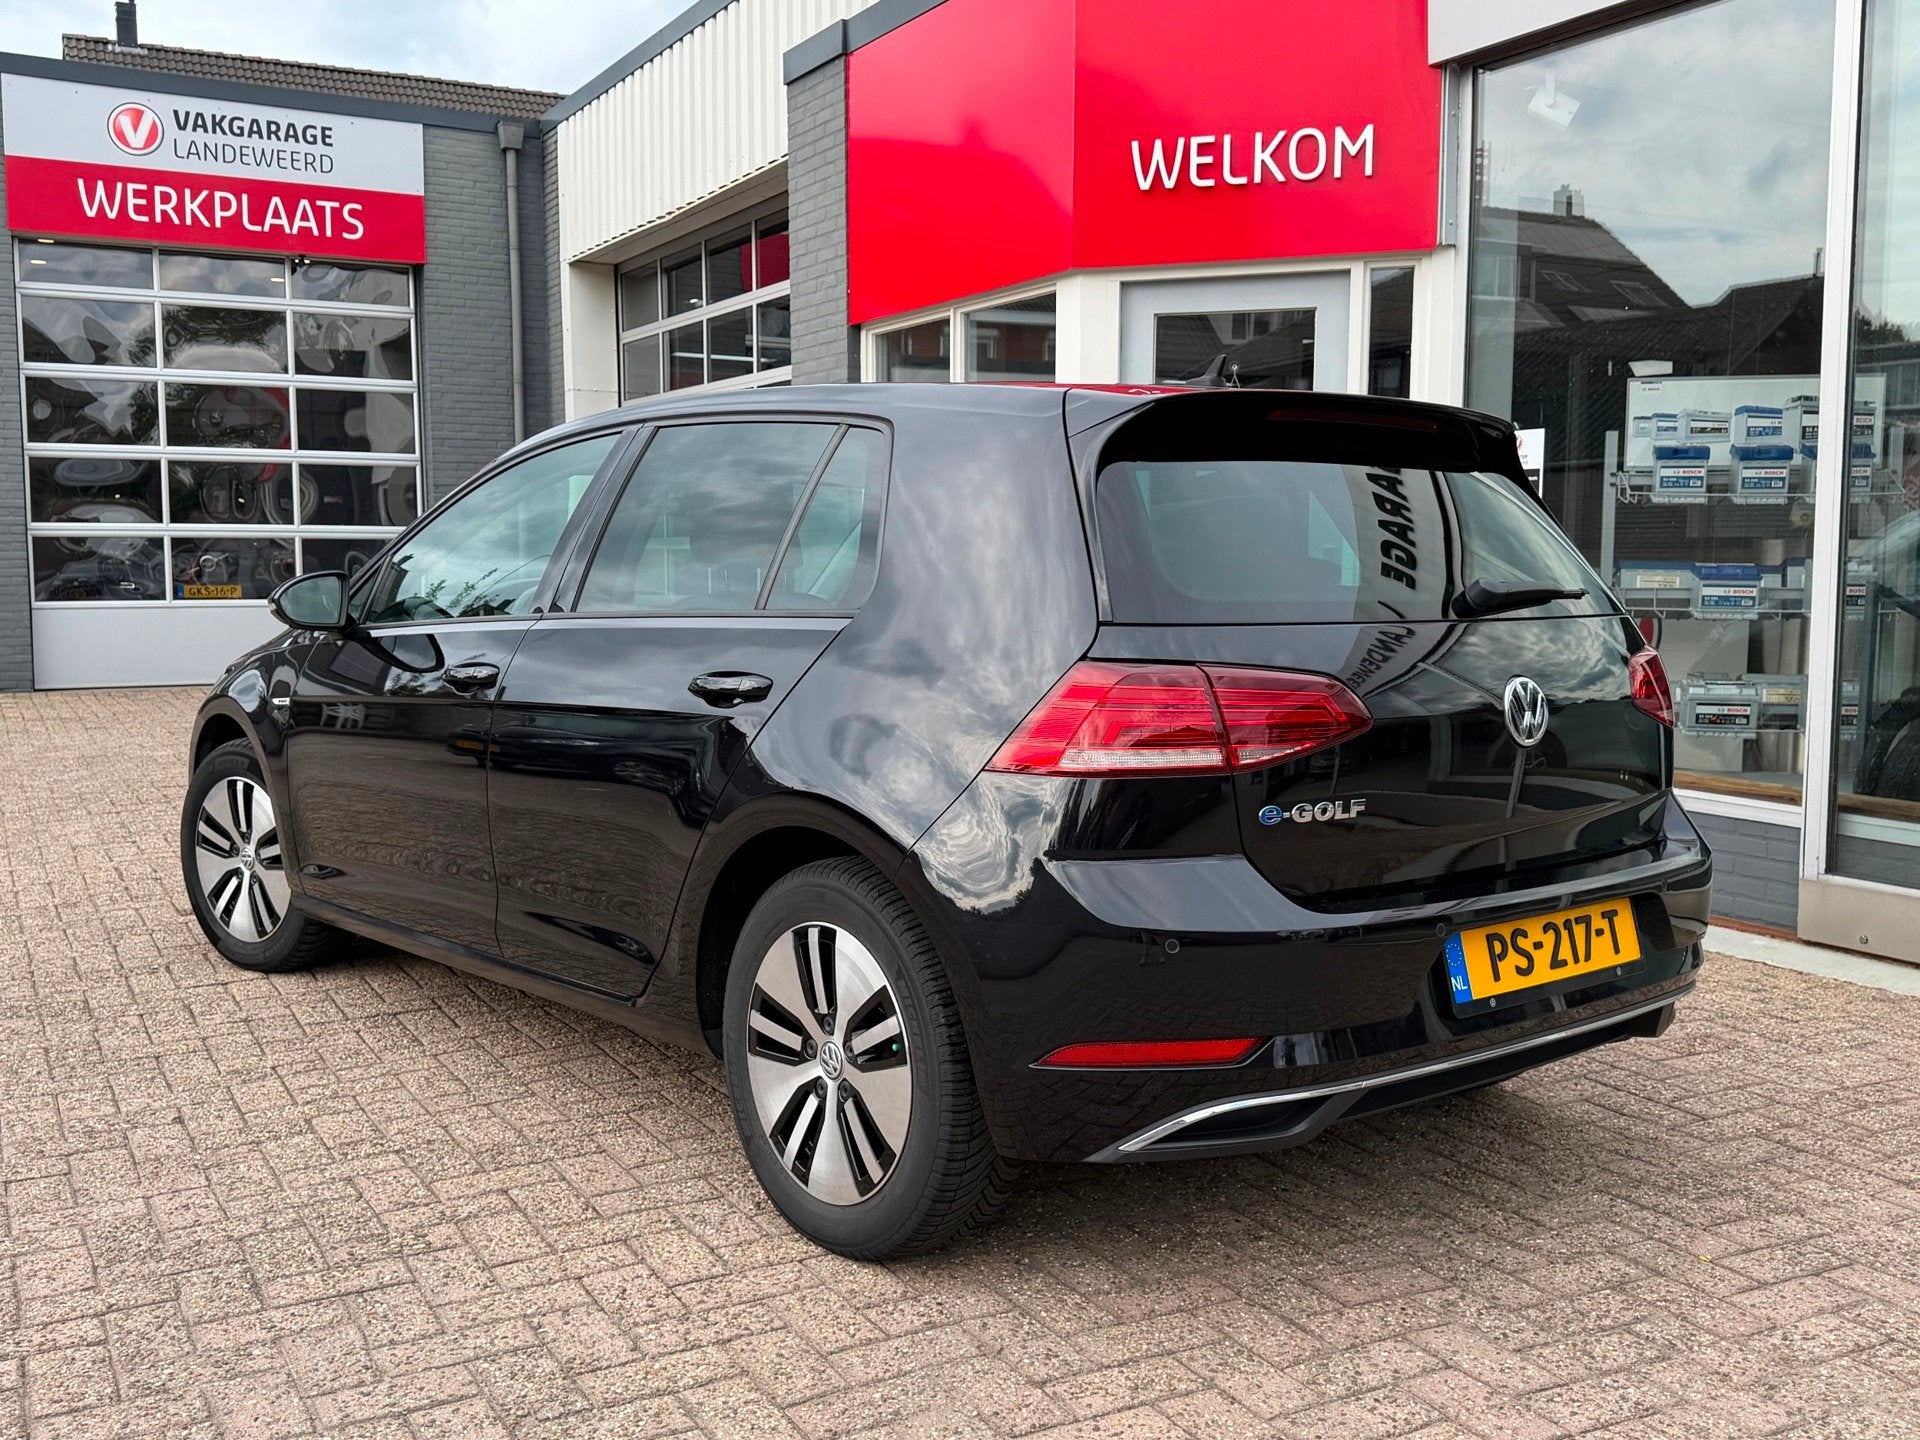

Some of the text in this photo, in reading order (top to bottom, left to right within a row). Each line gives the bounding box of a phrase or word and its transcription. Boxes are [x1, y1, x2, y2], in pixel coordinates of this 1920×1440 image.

[173, 109, 334, 147] VAKGARAGE
[173, 138, 334, 174] LANDEWEERD
[1131, 124, 1374, 191] WELKOM
[77, 178, 365, 240] WERKPLAATS
[188, 586, 237, 597] GKS-16-P
[1258, 798, 1367, 826] e-GOLF
[1485, 909, 1621, 983] PS-217-T
[1450, 976, 1468, 992] NL
